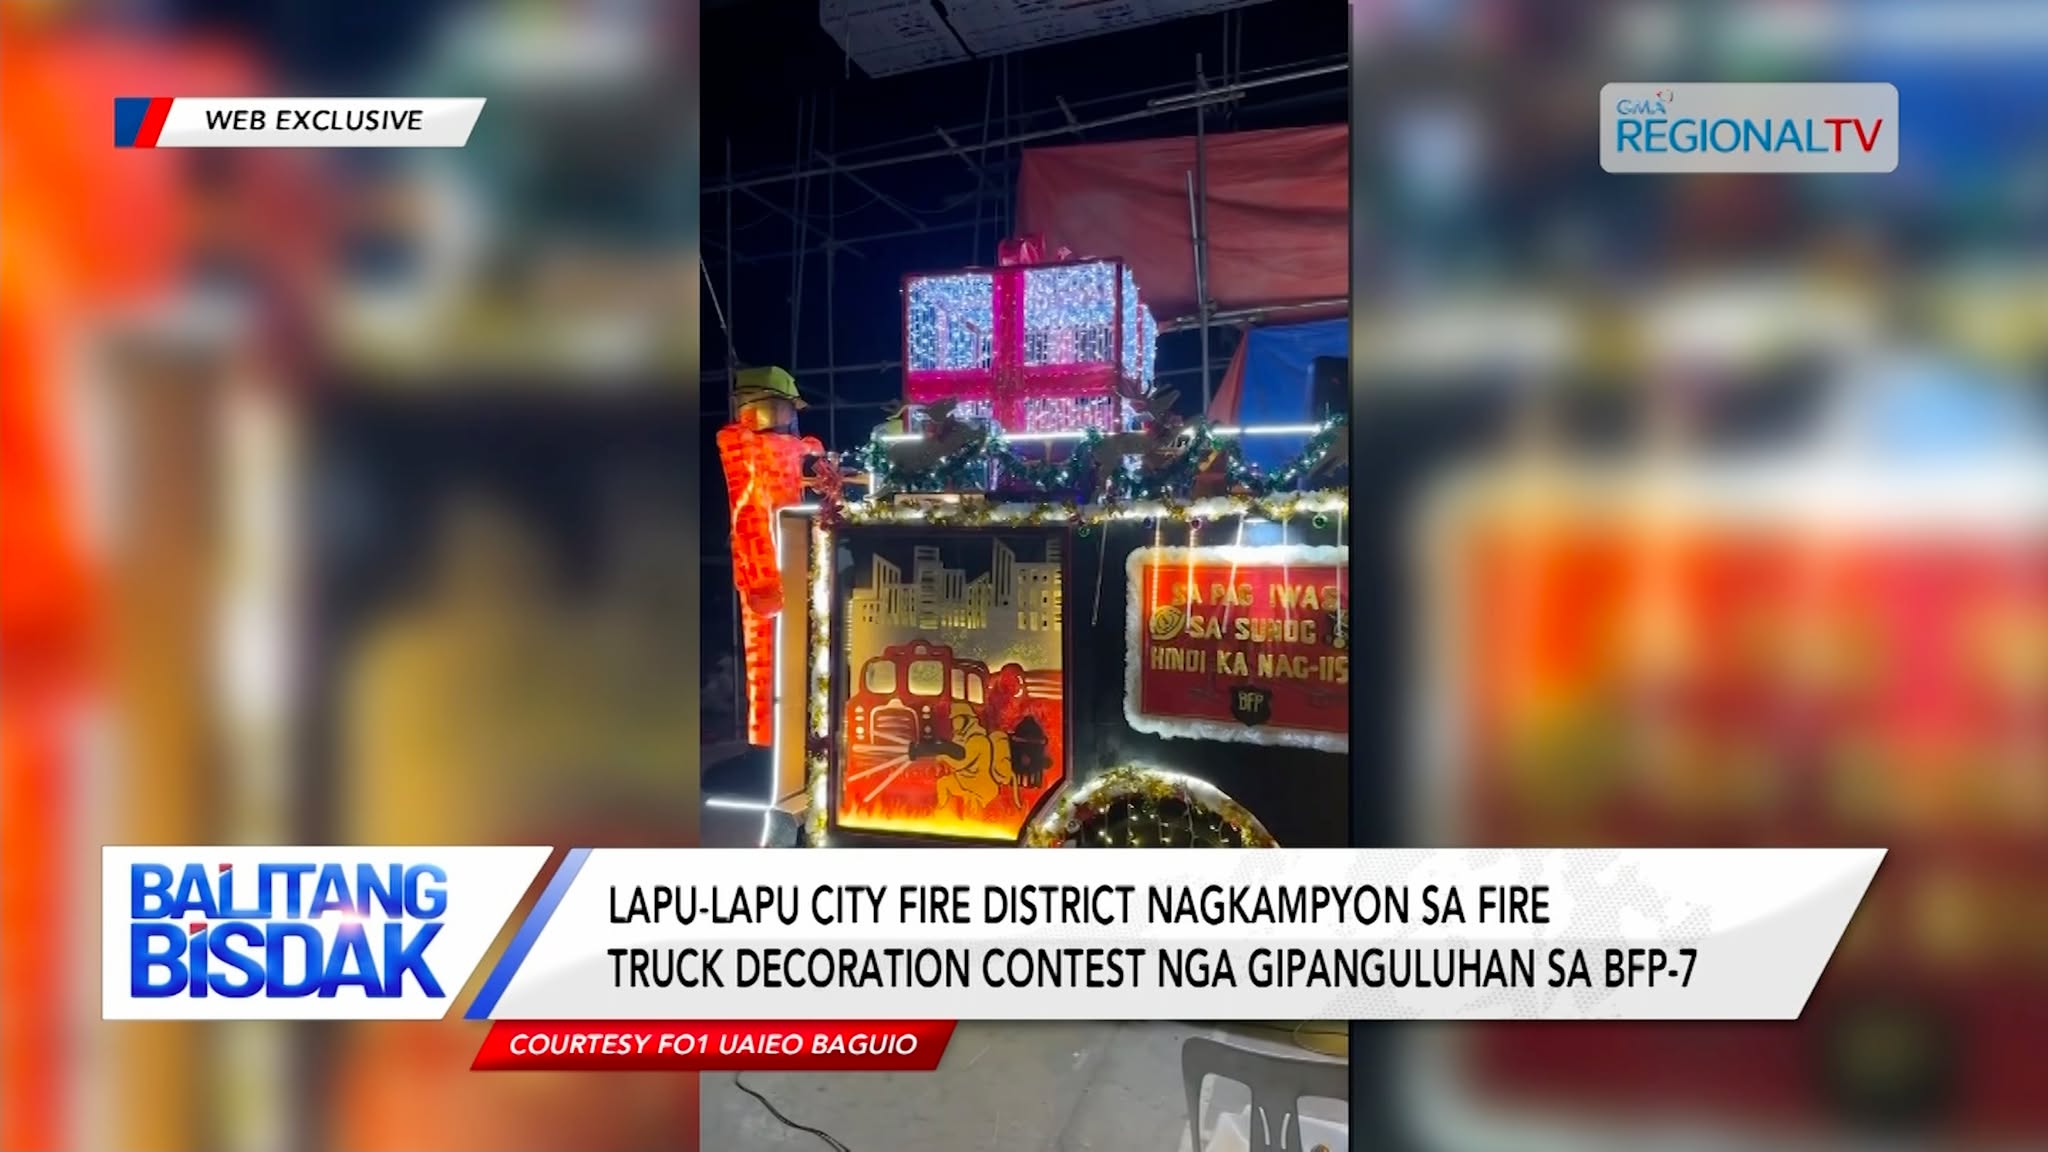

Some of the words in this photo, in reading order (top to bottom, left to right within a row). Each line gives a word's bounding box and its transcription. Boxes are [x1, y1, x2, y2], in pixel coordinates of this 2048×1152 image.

[1172, 583, 1203, 605] SA
[1210, 583, 1253, 607] PAG
[1269, 583, 1339, 611] IWAS
[1190, 615, 1222, 640] SA
[1234, 617, 1316, 645] SUNOG
[1151, 646, 1206, 674] HINDI
[1217, 649, 1249, 677] KA
[1238, 691, 1264, 713] BFP
